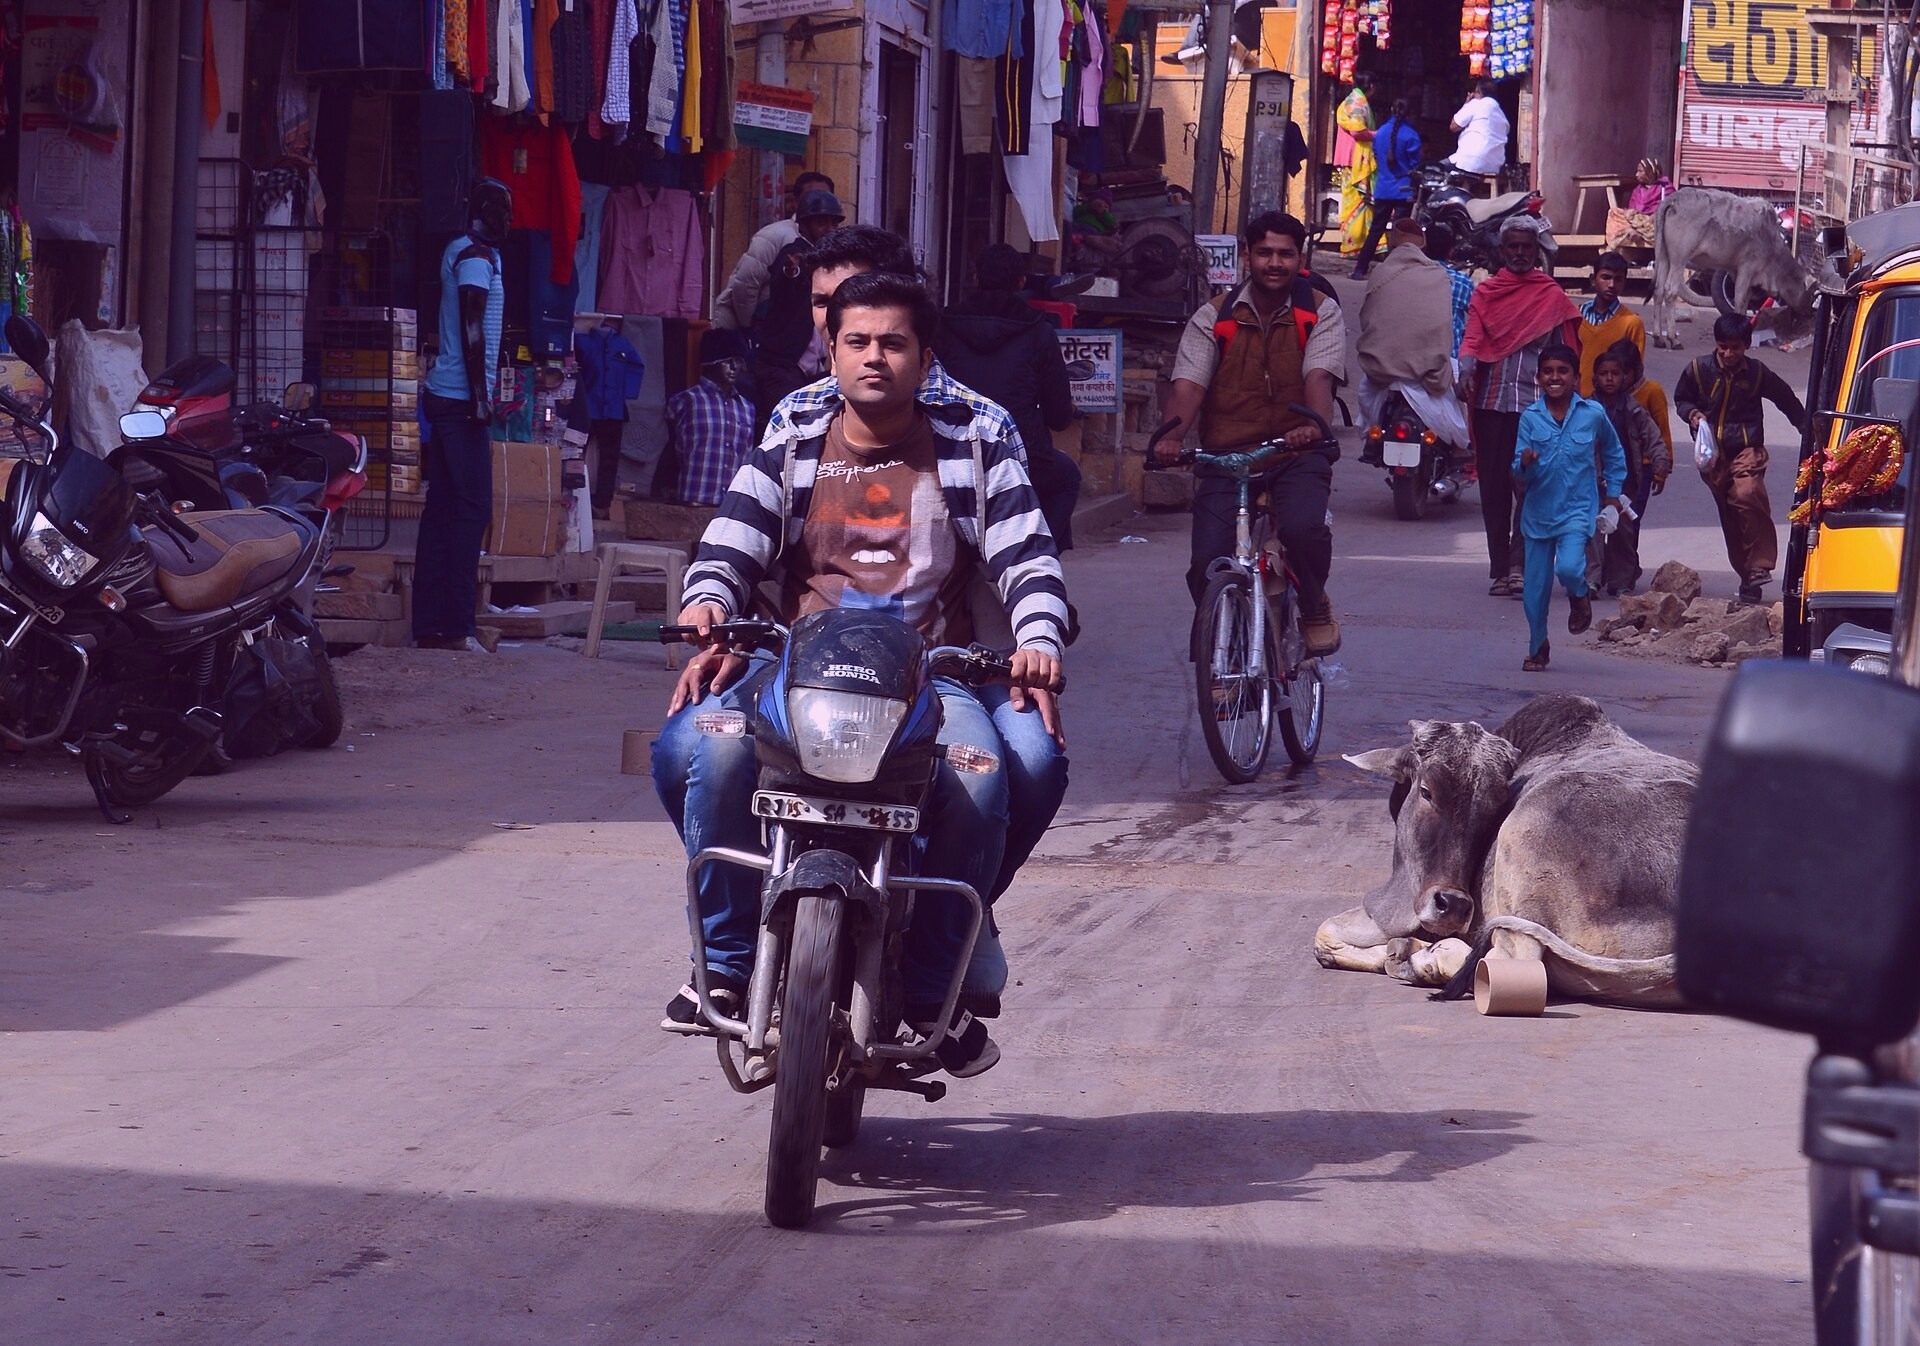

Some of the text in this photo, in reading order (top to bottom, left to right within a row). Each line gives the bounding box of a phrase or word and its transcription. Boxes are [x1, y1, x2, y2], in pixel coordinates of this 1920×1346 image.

[72, 519, 89, 534] Hero
[822, 670, 881, 685] HONDA
[828, 664, 876, 676] HERO
